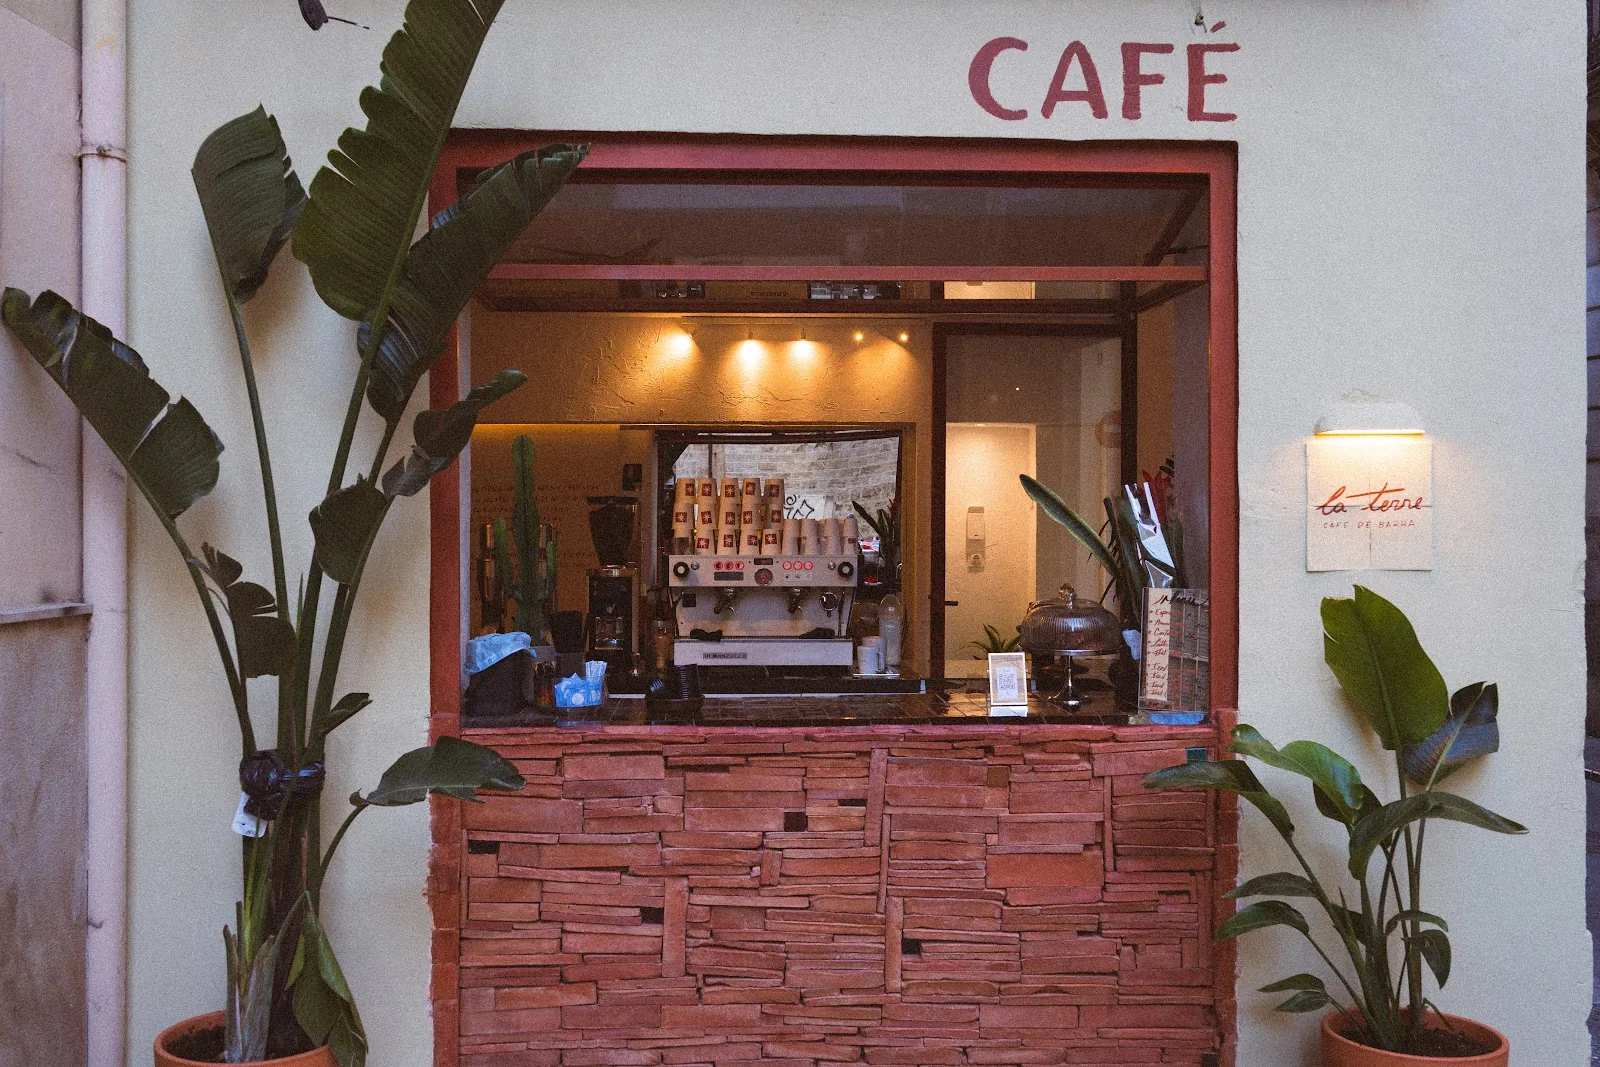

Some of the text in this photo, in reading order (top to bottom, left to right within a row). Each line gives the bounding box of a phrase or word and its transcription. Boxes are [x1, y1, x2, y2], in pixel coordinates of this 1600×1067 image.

[968, 21, 1241, 122] CAFÉ
[1316, 482, 1423, 516] la terre
[1378, 519, 1415, 528] BARRA
